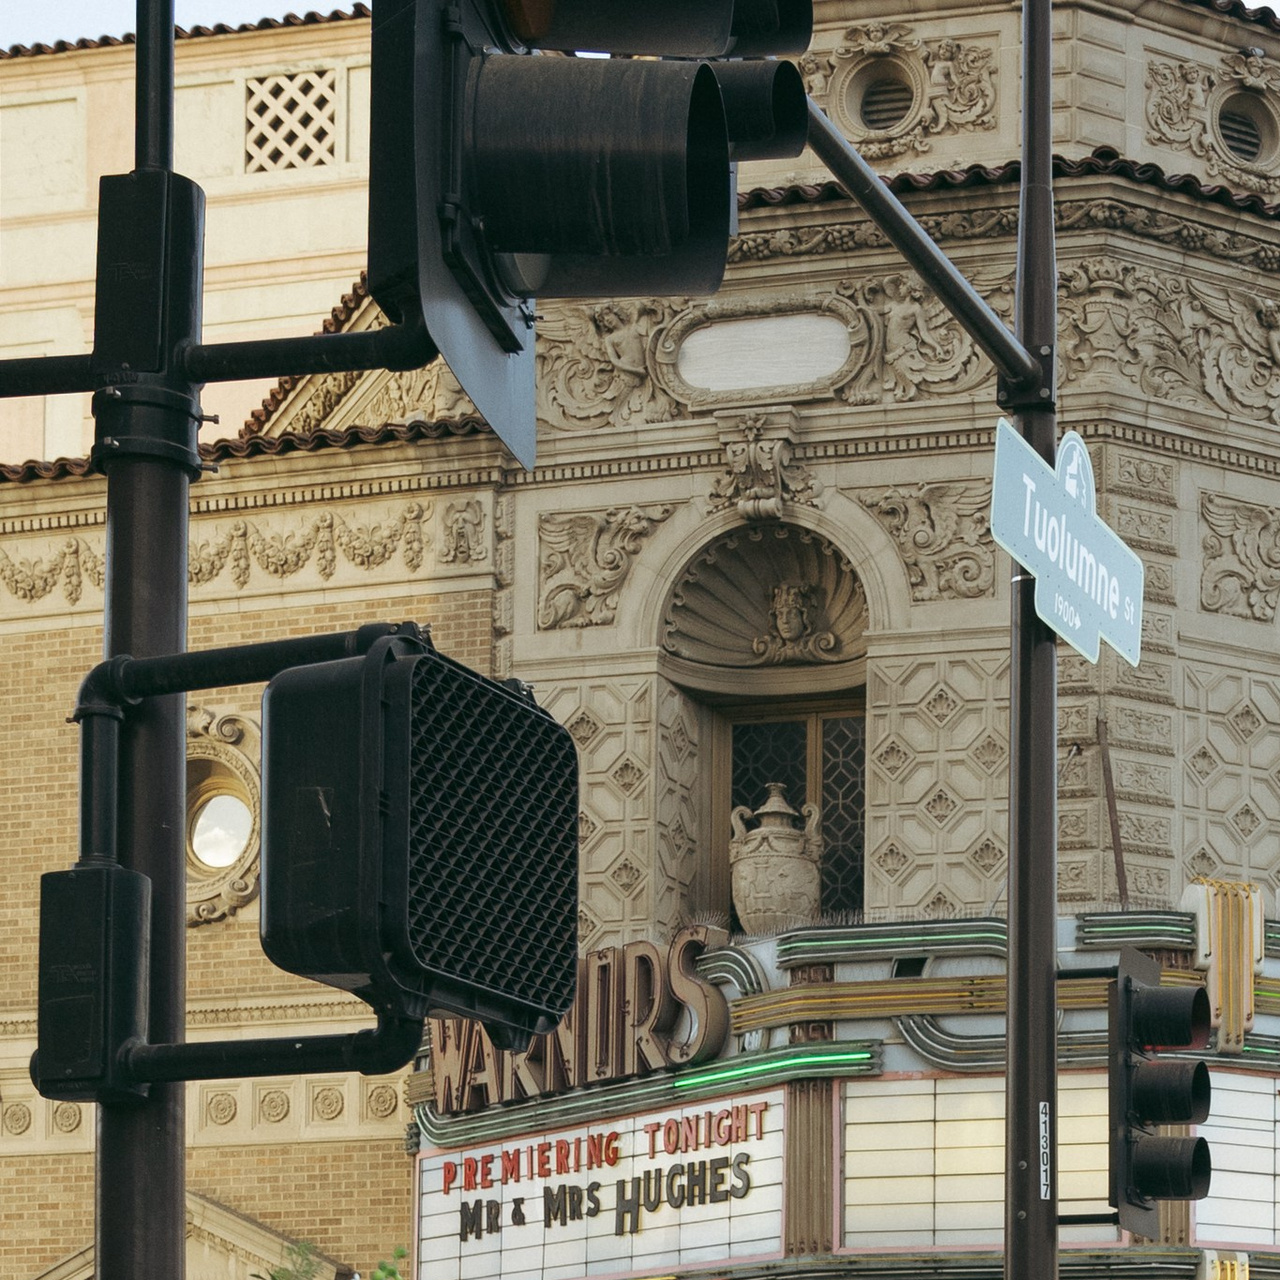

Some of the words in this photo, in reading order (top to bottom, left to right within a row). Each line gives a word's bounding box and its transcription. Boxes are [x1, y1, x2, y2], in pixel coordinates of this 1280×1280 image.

[1022, 472, 1120, 619] Tuolumne
[1123, 595, 1135, 625] St
[1054, 592, 1076, 629] 1900
[442, 1131, 619, 1195] PREMIERING
[644, 1101, 768, 1159] TONIGHT
[1040, 1102, 1050, 1199] 413017
[459, 1198, 501, 1242] MR
[510, 1196, 526, 1226] &
[543, 1181, 601, 1228] MRS
[614, 1151, 751, 1236] HUGHES
